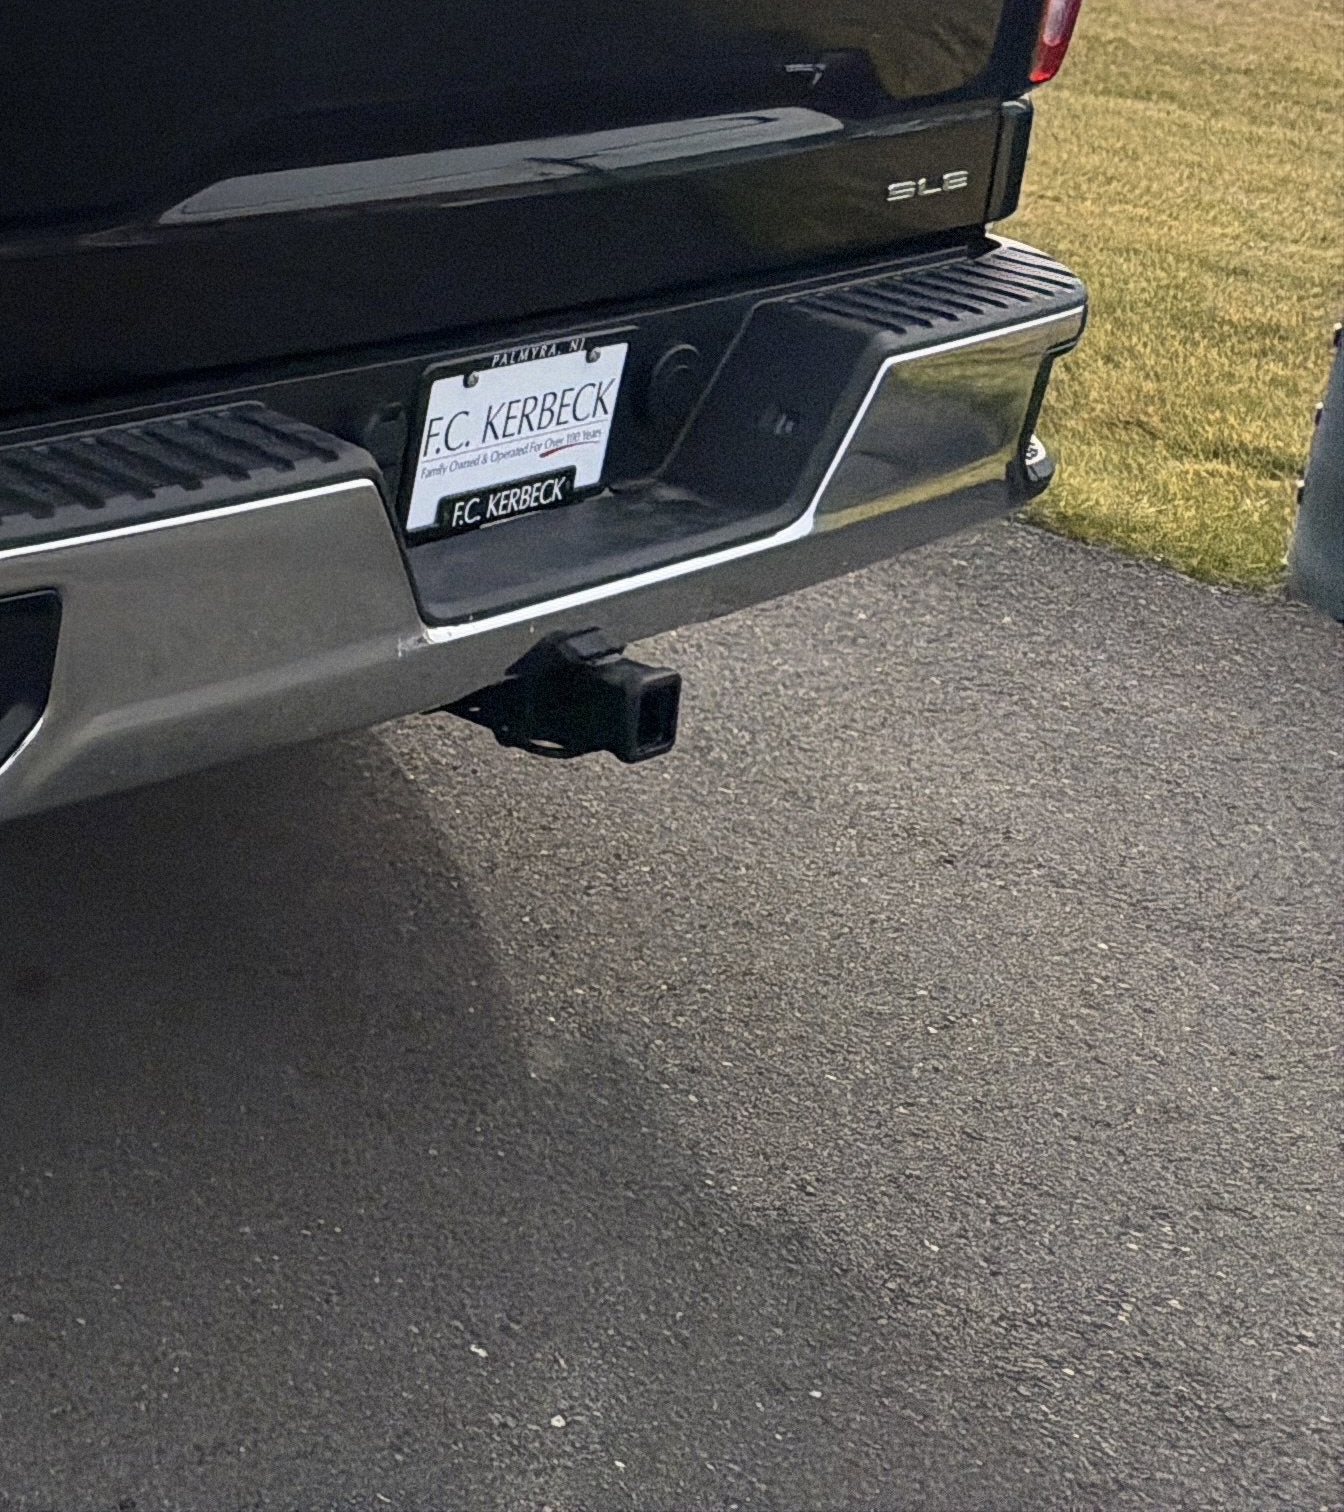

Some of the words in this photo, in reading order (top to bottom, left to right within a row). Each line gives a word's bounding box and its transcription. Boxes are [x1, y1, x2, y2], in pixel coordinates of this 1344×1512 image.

[886, 170, 969, 202] SLE
[422, 410, 471, 458] F.C.
[482, 378, 617, 445] KERBECK
[482, 453, 489, 465] &
[451, 498, 482, 527] F.C.
[486, 476, 567, 520] KERBECK
